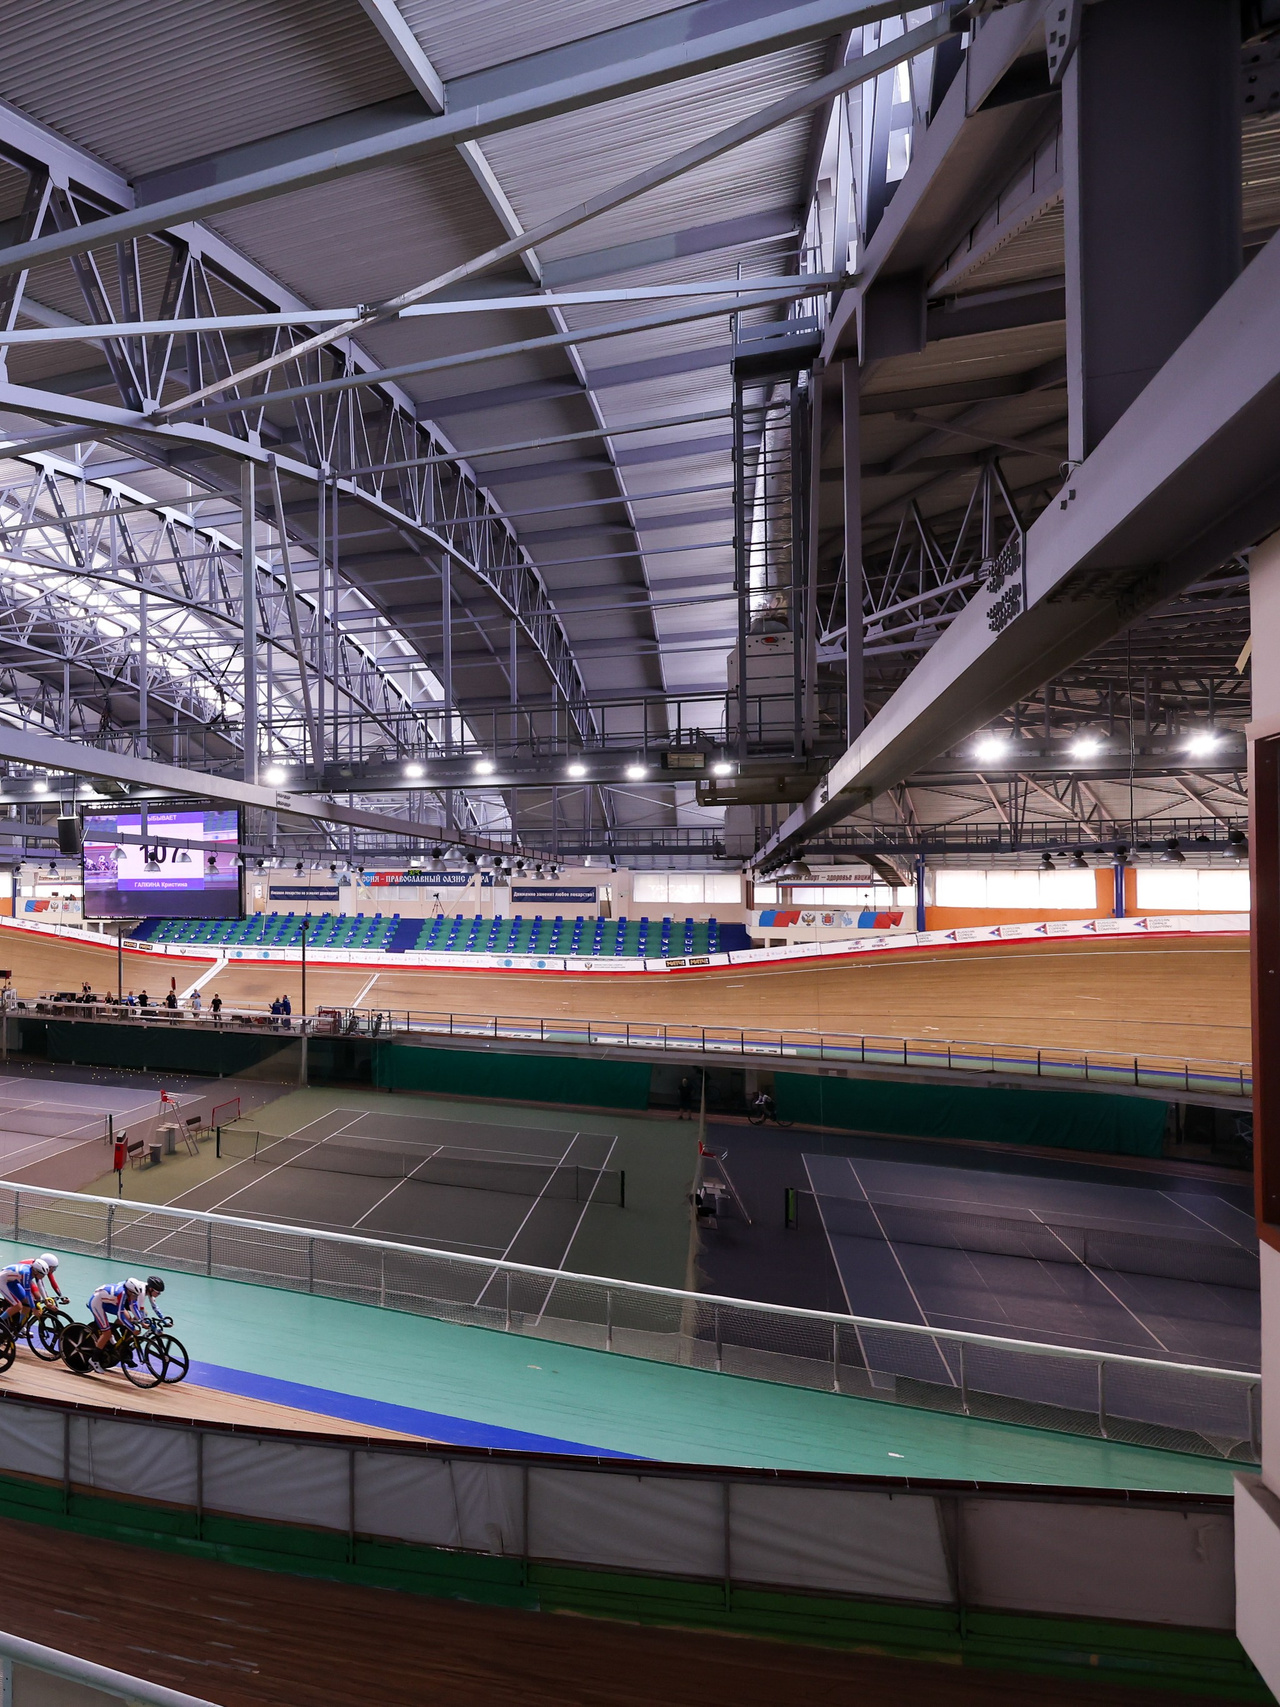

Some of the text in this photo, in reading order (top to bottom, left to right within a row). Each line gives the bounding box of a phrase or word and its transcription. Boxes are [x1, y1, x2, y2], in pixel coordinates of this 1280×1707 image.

[147, 814, 177, 822] ЫБЫВАЕТ
[139, 845, 180, 864] 107
[385, 874, 441, 883] ПРАВОСЛАВНЫЙ
[442, 875, 466, 883] ОАЗИС
